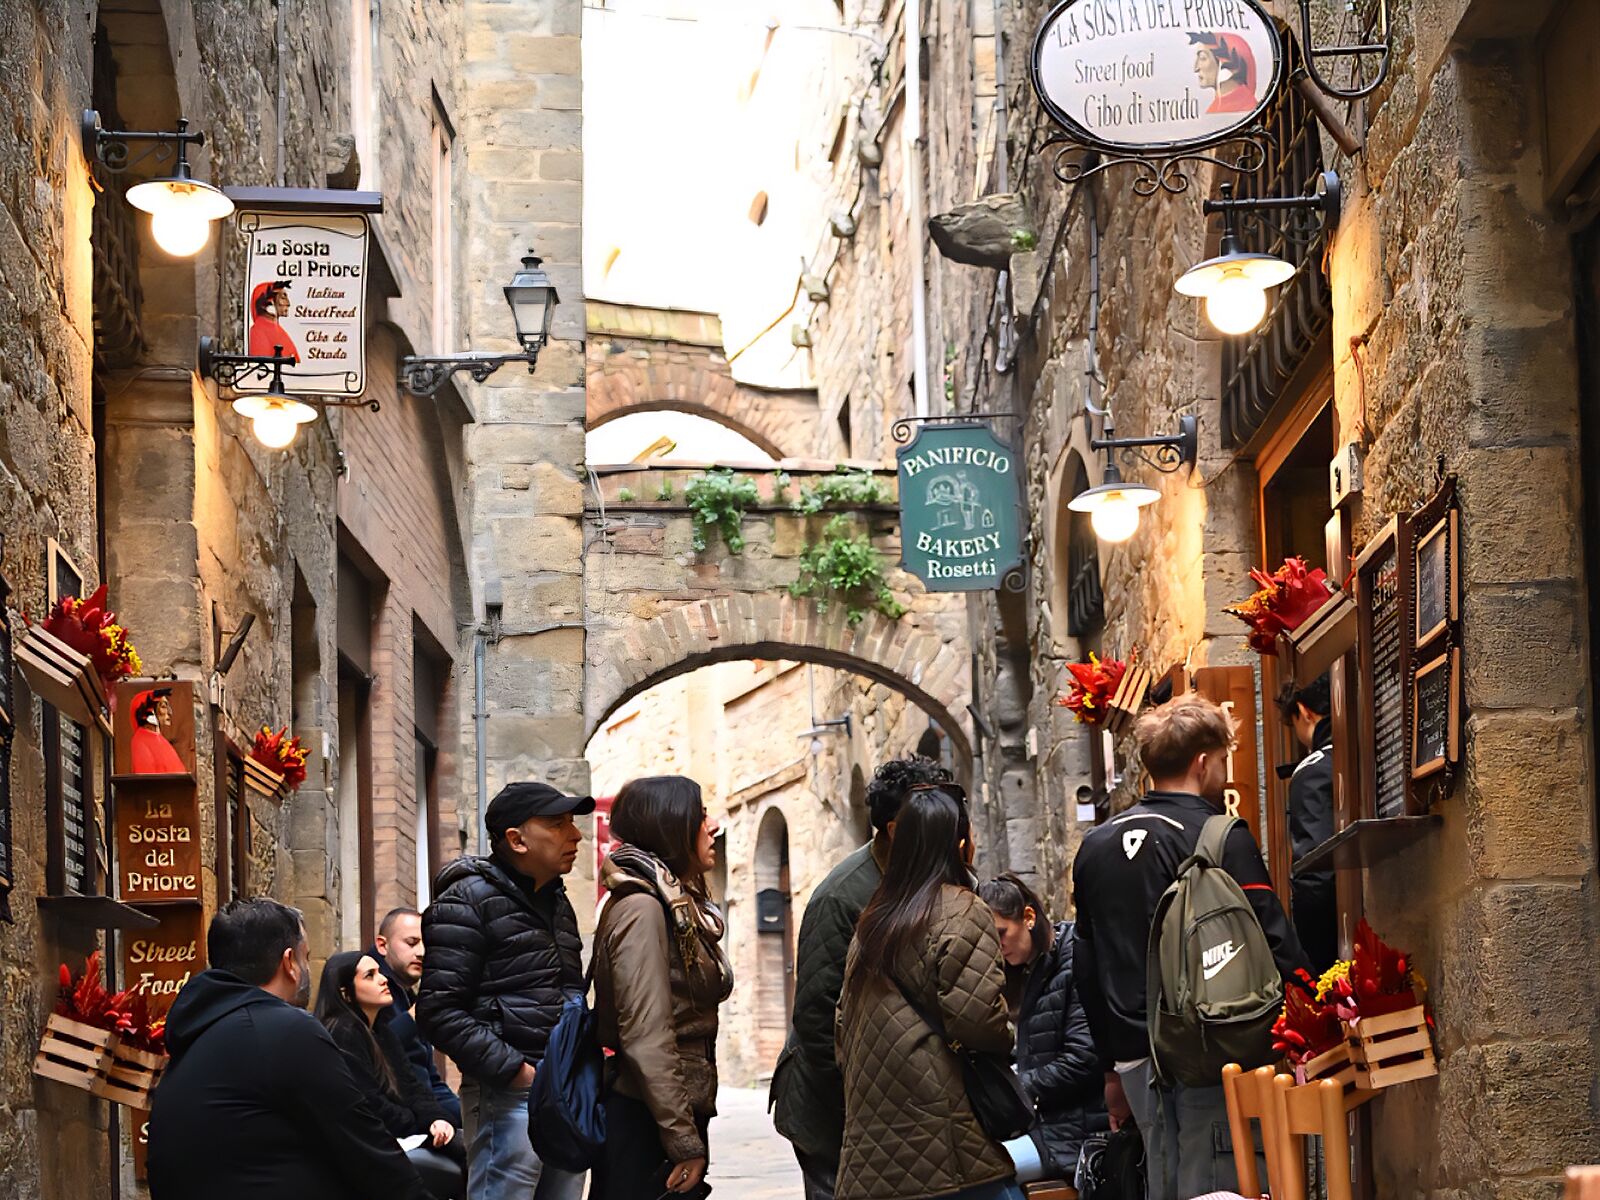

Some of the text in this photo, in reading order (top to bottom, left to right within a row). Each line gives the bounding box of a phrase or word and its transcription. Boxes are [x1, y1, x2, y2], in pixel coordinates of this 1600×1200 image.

[1084, 0, 1142, 40] SOSTA
[1145, 0, 1181, 29] DEL
[1184, 0, 1250, 30] PRIORE
[1074, 52, 1155, 87] Street food
[1083, 87, 1200, 130] Cibo di strada
[255, 239, 331, 257] La Sosta
[276, 260, 361, 278] del Priore
[306, 286, 346, 299] Italian
[305, 330, 348, 343] Cibo da
[307, 347, 347, 359] Strada
[902, 446, 1010, 478] PANIFICIO
[916, 531, 1002, 558] BAKERY
[926, 558, 997, 579] Rosetti
[144, 799, 173, 819] La
[128, 824, 191, 844] Sosta
[144, 848, 175, 868] del
[127, 871, 197, 892] Priore
[129, 939, 197, 964] Street
[1202, 940, 1233, 968] NIKE
